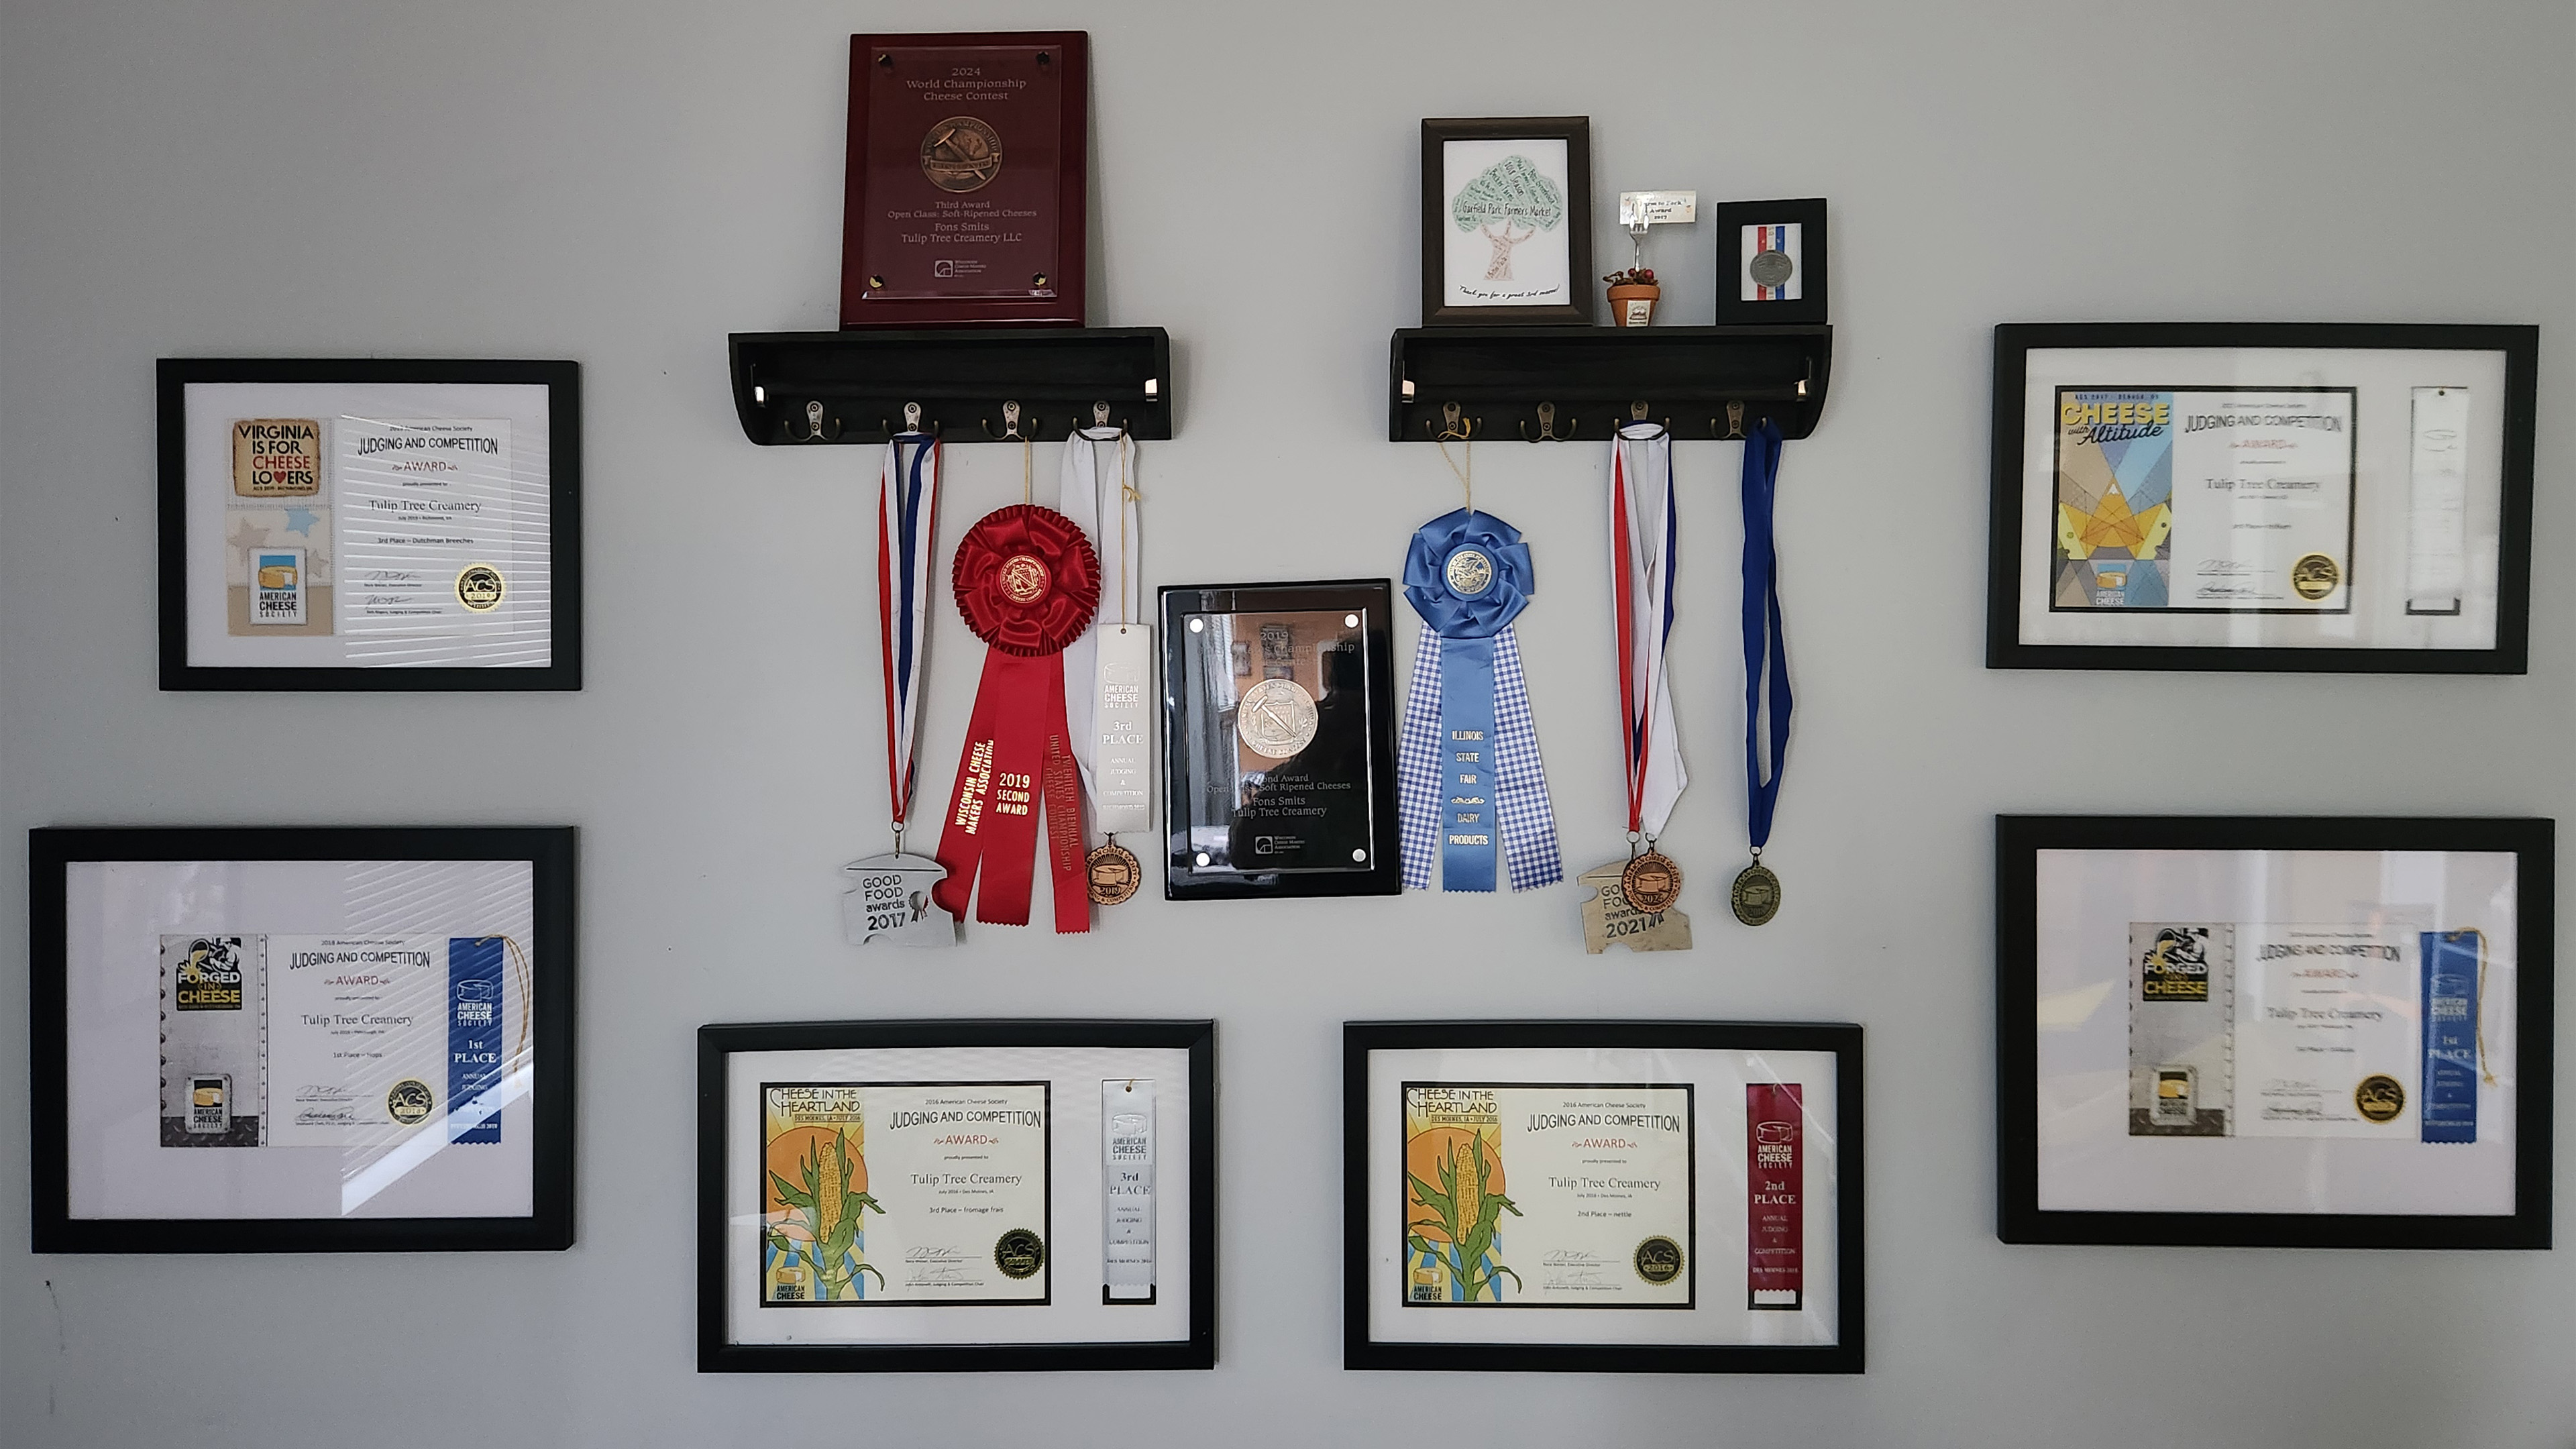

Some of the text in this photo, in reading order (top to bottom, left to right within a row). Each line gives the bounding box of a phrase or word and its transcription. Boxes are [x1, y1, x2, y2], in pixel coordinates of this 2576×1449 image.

[952, 68, 981, 76] 2024
[907, 79, 1026, 89] World Championship
[924, 92, 1008, 101] Cheese Contest
[888, 211, 911, 219] Open
[942, 209, 1000, 219] Soft-Ripened
[1489, 203, 1502, 215] Park
[1504, 203, 1528, 215] Farmers
[1530, 206, 1552, 216] Market
[935, 222, 989, 231] Fons Smits
[902, 233, 1022, 244] Tulip Tree Creamery LLC
[2061, 402, 2169, 425] CHEESE
[2185, 415, 2260, 433] JUDGING AND
[238, 425, 314, 439] VIRGINIA
[2068, 419, 2164, 445] with Altitude
[253, 441, 303, 454] IS FOR
[358, 437, 498, 455] JUDGING AND COMPETITION
[253, 456, 310, 469] CHEESE
[404, 462, 446, 472] AWARD
[252, 471, 313, 484] LOERS
[369, 500, 482, 513] Tulip Tree Creamery
[465, 580, 496, 592] ACS
[260, 592, 296, 600] AMERICAN
[260, 602, 297, 610] CHEESE
[1260, 632, 1289, 641] 2019
[1104, 685, 1138, 693] AMERICAN
[1104, 694, 1138, 702] CHEESE
[1114, 721, 1132, 731] 3rd
[1103, 735, 1143, 744] PLACE
[1452, 731, 1483, 741] ILLINOIS
[1456, 753, 1479, 762] STATE
[955, 742, 985, 825] WISCONSIN CHEESE
[1000, 773, 1030, 788] 2019
[1281, 774, 1309, 782] Award
[1460, 774, 1477, 784] FAIR
[965, 740, 994, 835] MAKERS ASSOCIATION
[1260, 784, 1277, 792] Soft
[1280, 783, 1314, 792] Ripened
[997, 790, 1030, 802] SECOND
[1253, 797, 1306, 806] Fons Smits
[996, 802, 1028, 815] AWARD
[1050, 735, 1071, 871] UNITED STATES CHAMPIONSHIP
[1232, 808, 1327, 818] Tulip Tree Creamery
[1457, 813, 1480, 823] DAIRY
[1449, 835, 1489, 845] PRODUCTS
[863, 875, 902, 888] GOOD
[865, 887, 903, 901] FOOD
[1100, 887, 1121, 895] 2019
[1601, 883, 1622, 896] GO
[866, 899, 905, 912] awards
[867, 912, 905, 930] 2017
[1606, 917, 1646, 938] 2021
[289, 951, 430, 970] JUDGING AND COMPETITION
[2144, 963, 2207, 974] FORGED
[178, 972, 240, 983] FORGED
[336, 976, 379, 985] AWARD
[2145, 981, 2207, 994] CHEESE
[178, 990, 240, 1003] CHEESE
[458, 1002, 492, 1011] AMERICAN
[301, 1014, 413, 1027] Tulip Tree Creamery
[458, 1011, 492, 1020] CHEESE
[468, 1040, 483, 1049] 1st
[454, 1053, 496, 1063] PLACE
[393, 1093, 427, 1106] ACS
[770, 1088, 857, 1108] CHEESE IN THE
[1407, 1088, 1493, 1108] CHEESE IN THE
[781, 1101, 860, 1117] HEARTLAND
[1418, 1102, 1497, 1118] HEARTLAND
[890, 1110, 1041, 1130] JUDGING AND COMPETITION
[1527, 1114, 1680, 1132] JUDGING AND COMPETITION
[945, 1135, 987, 1144] AWARD
[1583, 1139, 1625, 1148] AWARD
[1113, 1145, 1146, 1154] CHEESE
[1758, 1144, 1792, 1153] AMERICAN
[1758, 1154, 1792, 1162] CHEESE
[910, 1173, 1022, 1187] Tulip Tree Creamery
[1120, 1173, 1138, 1181] 3rd
[1548, 1177, 1660, 1191] Tulip Tree Creamery
[1765, 1181, 1784, 1190] 2nd
[1110, 1185, 1151, 1195] PLACE
[1754, 1194, 1796, 1204] PLACE
[1002, 1244, 1034, 1256] ACS
[1642, 1250, 1673, 1263] ACS
[777, 1292, 805, 1300] CHEESE
